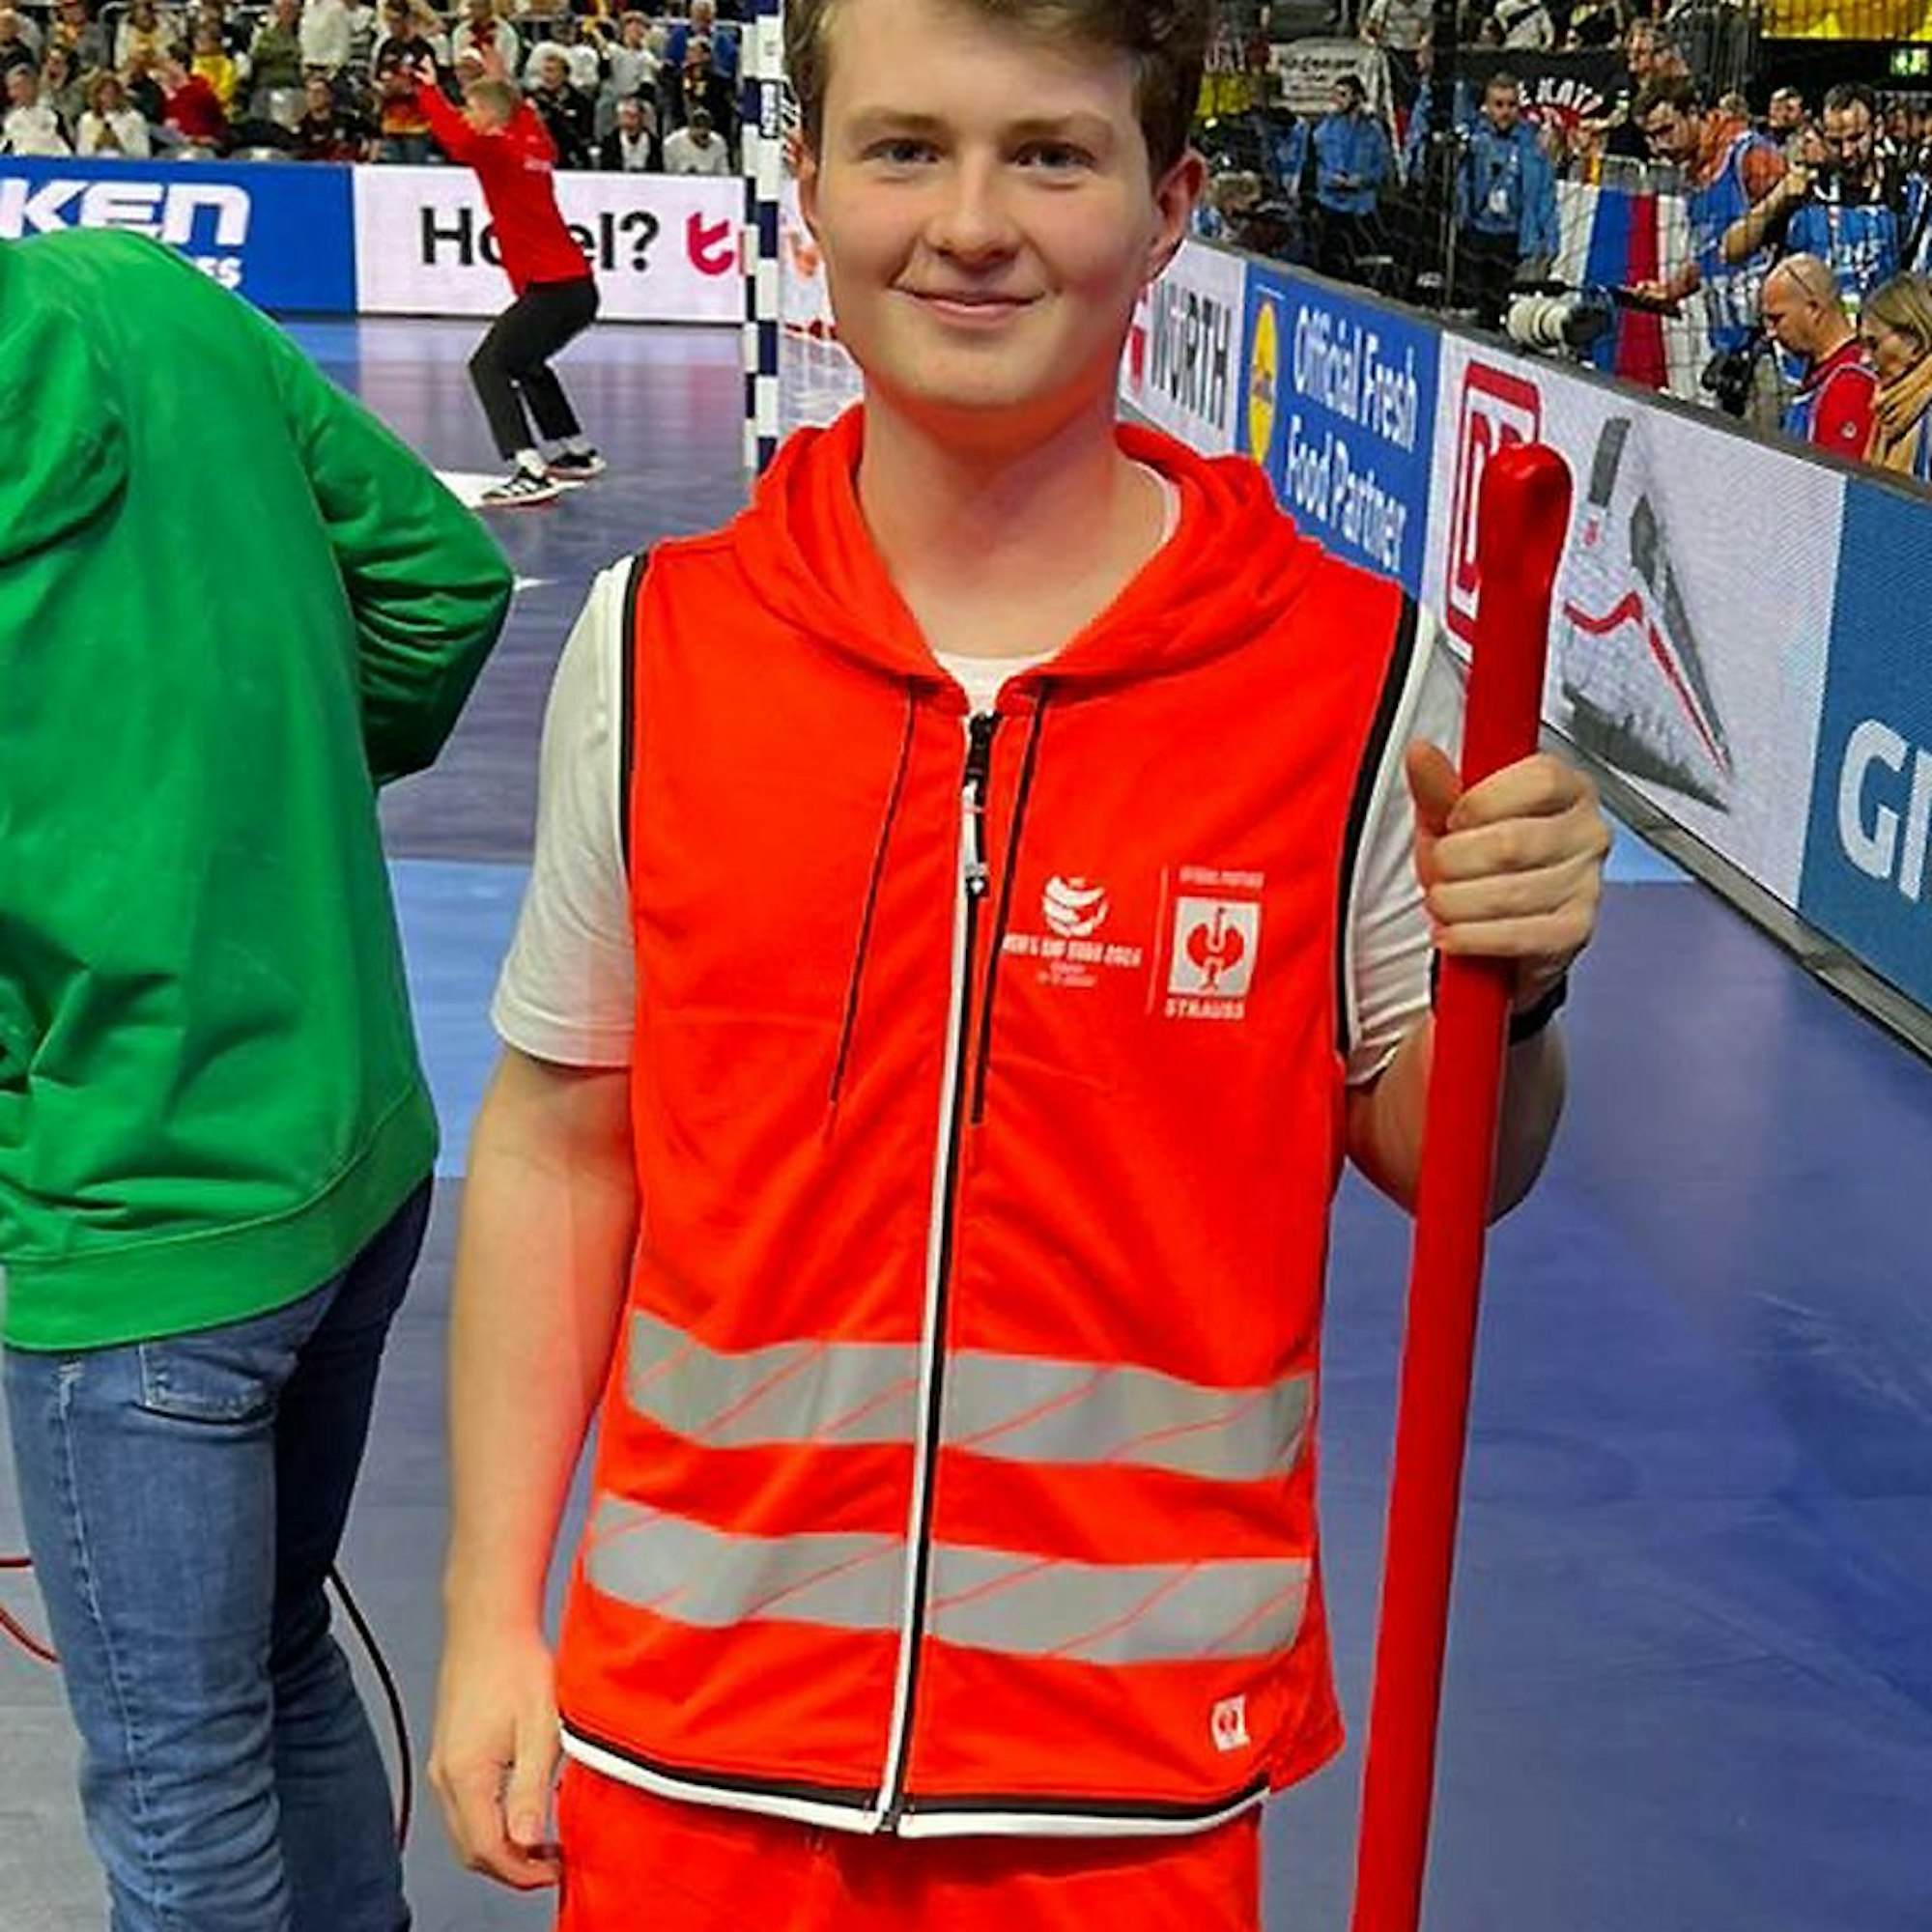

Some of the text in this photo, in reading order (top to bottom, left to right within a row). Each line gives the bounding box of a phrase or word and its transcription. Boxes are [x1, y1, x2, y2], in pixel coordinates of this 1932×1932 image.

[1293, 304, 1418, 454] Official Fresh
[1285, 414, 1407, 573] Food Partner
